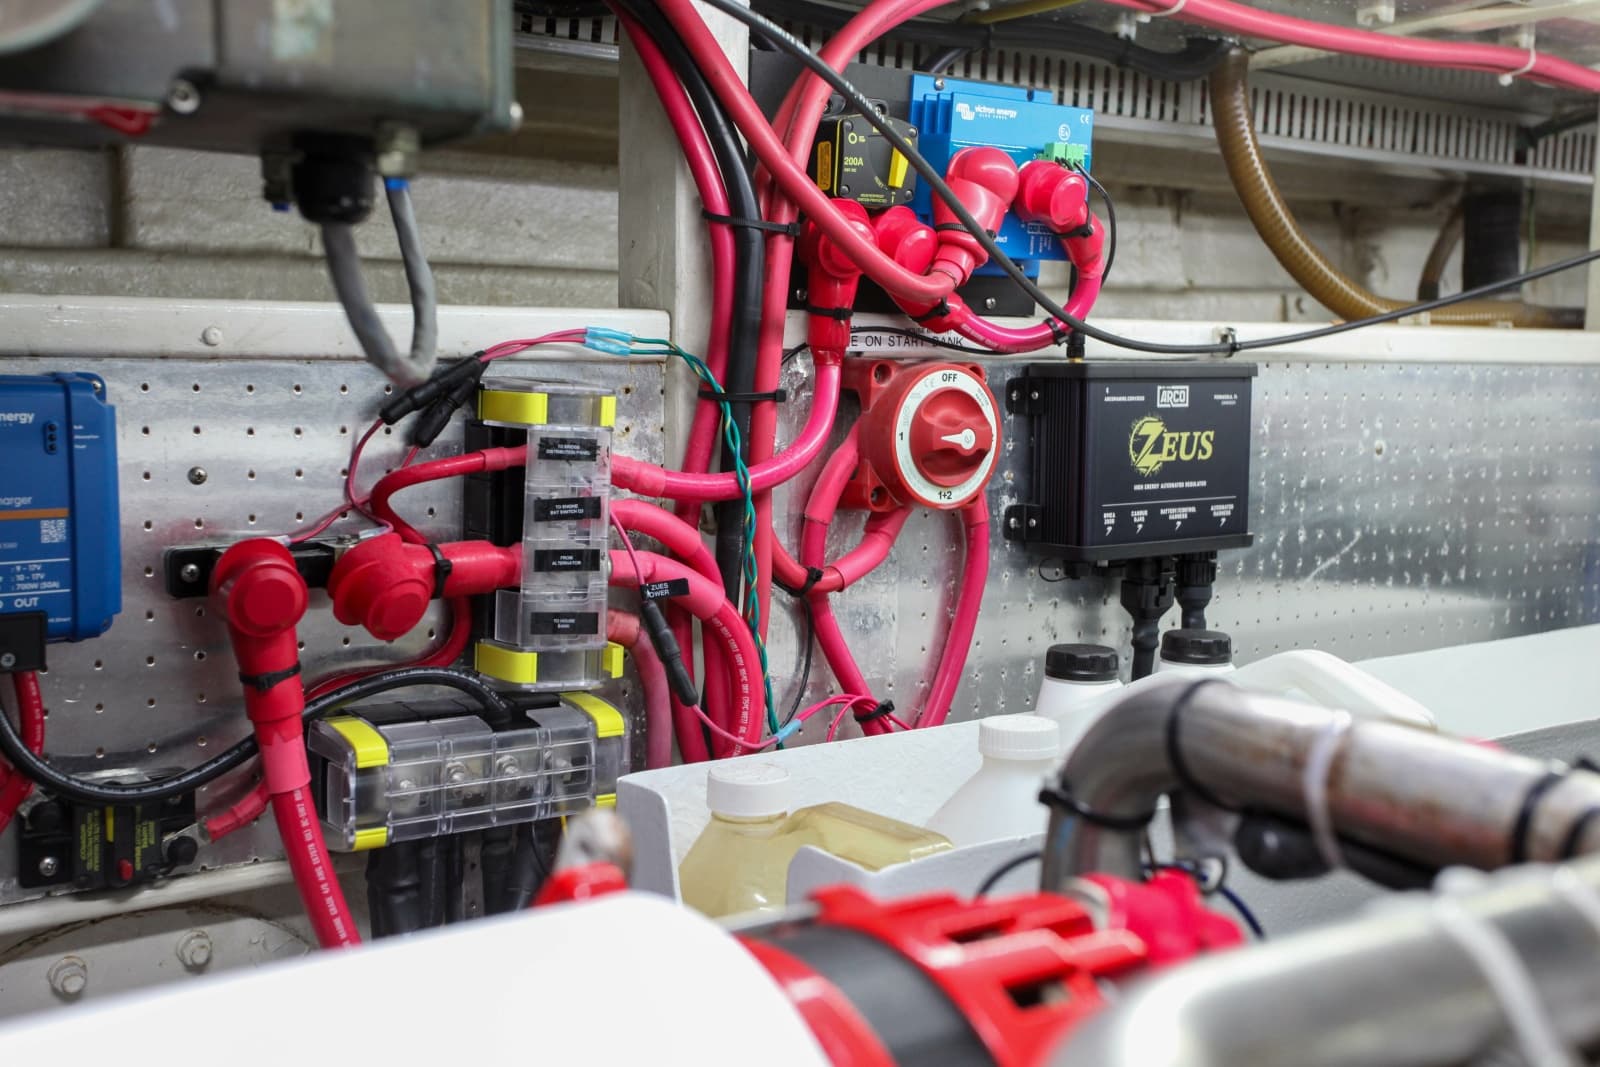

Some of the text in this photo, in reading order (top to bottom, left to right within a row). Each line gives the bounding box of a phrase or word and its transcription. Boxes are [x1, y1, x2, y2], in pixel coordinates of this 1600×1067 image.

[975, 105, 1017, 119] victron energy
[844, 156, 864, 167] 200A
[865, 335, 882, 347] ON
[941, 373, 958, 382] OFF
[1160, 389, 1186, 406] ARCO
[0, 412, 35, 424] nergy
[899, 432, 904, 441] 1
[1134, 419, 1215, 468] ZEUS
[938, 491, 953, 500] 1+2
[651, 582, 669, 590] ZUES
[14, 597, 39, 608] OUT
